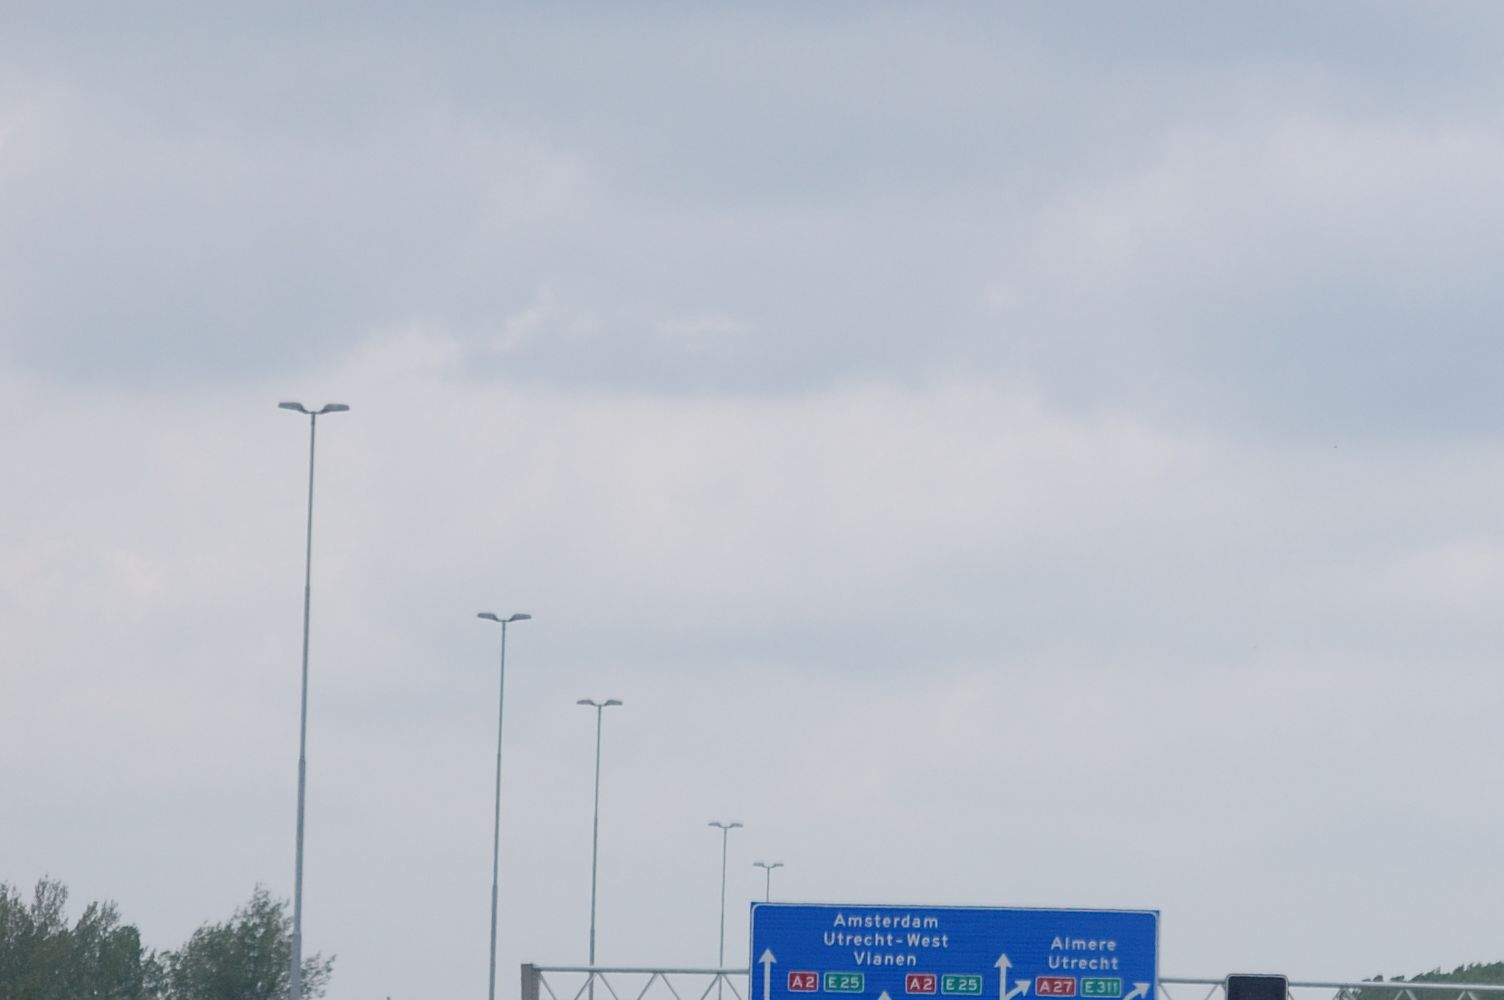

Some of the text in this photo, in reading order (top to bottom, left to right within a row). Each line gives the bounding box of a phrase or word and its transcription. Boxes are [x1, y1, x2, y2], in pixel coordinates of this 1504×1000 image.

[833, 913, 939, 929] Amsterdam
[823, 931, 949, 948] Utrecht-West
[1050, 936, 1116, 951] Almere
[1048, 955, 1119, 970] Utrecht
